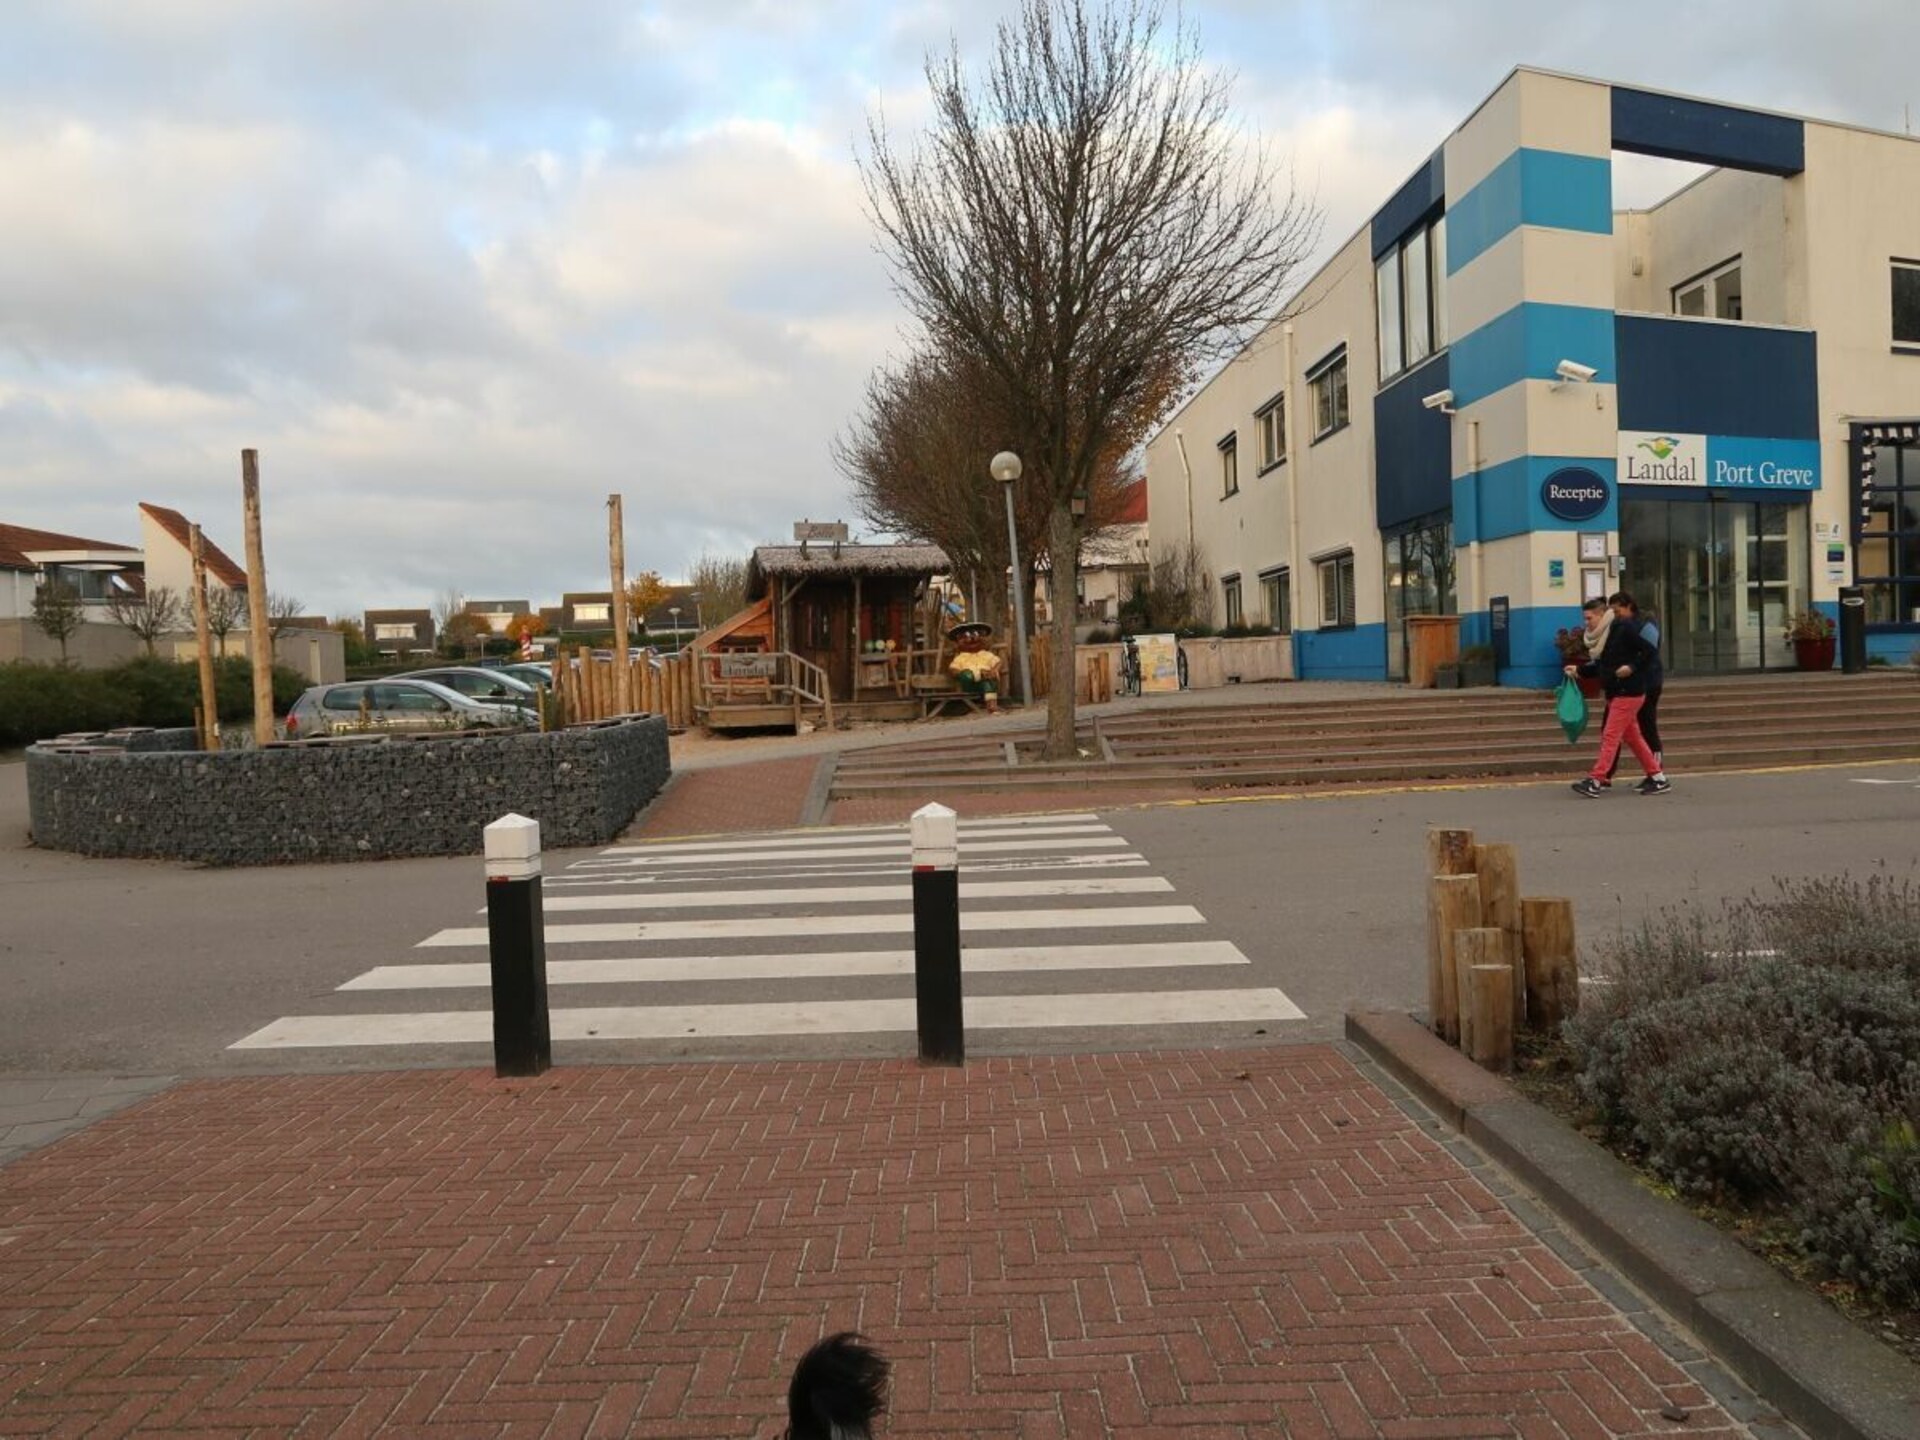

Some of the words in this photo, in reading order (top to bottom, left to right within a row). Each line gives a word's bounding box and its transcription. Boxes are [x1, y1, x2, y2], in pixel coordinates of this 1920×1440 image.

[1627, 456, 1697, 482] Landal
[1714, 460, 1755, 484] Port
[1759, 462, 1814, 486] Greve
[1549, 484, 1605, 502] Receptie
